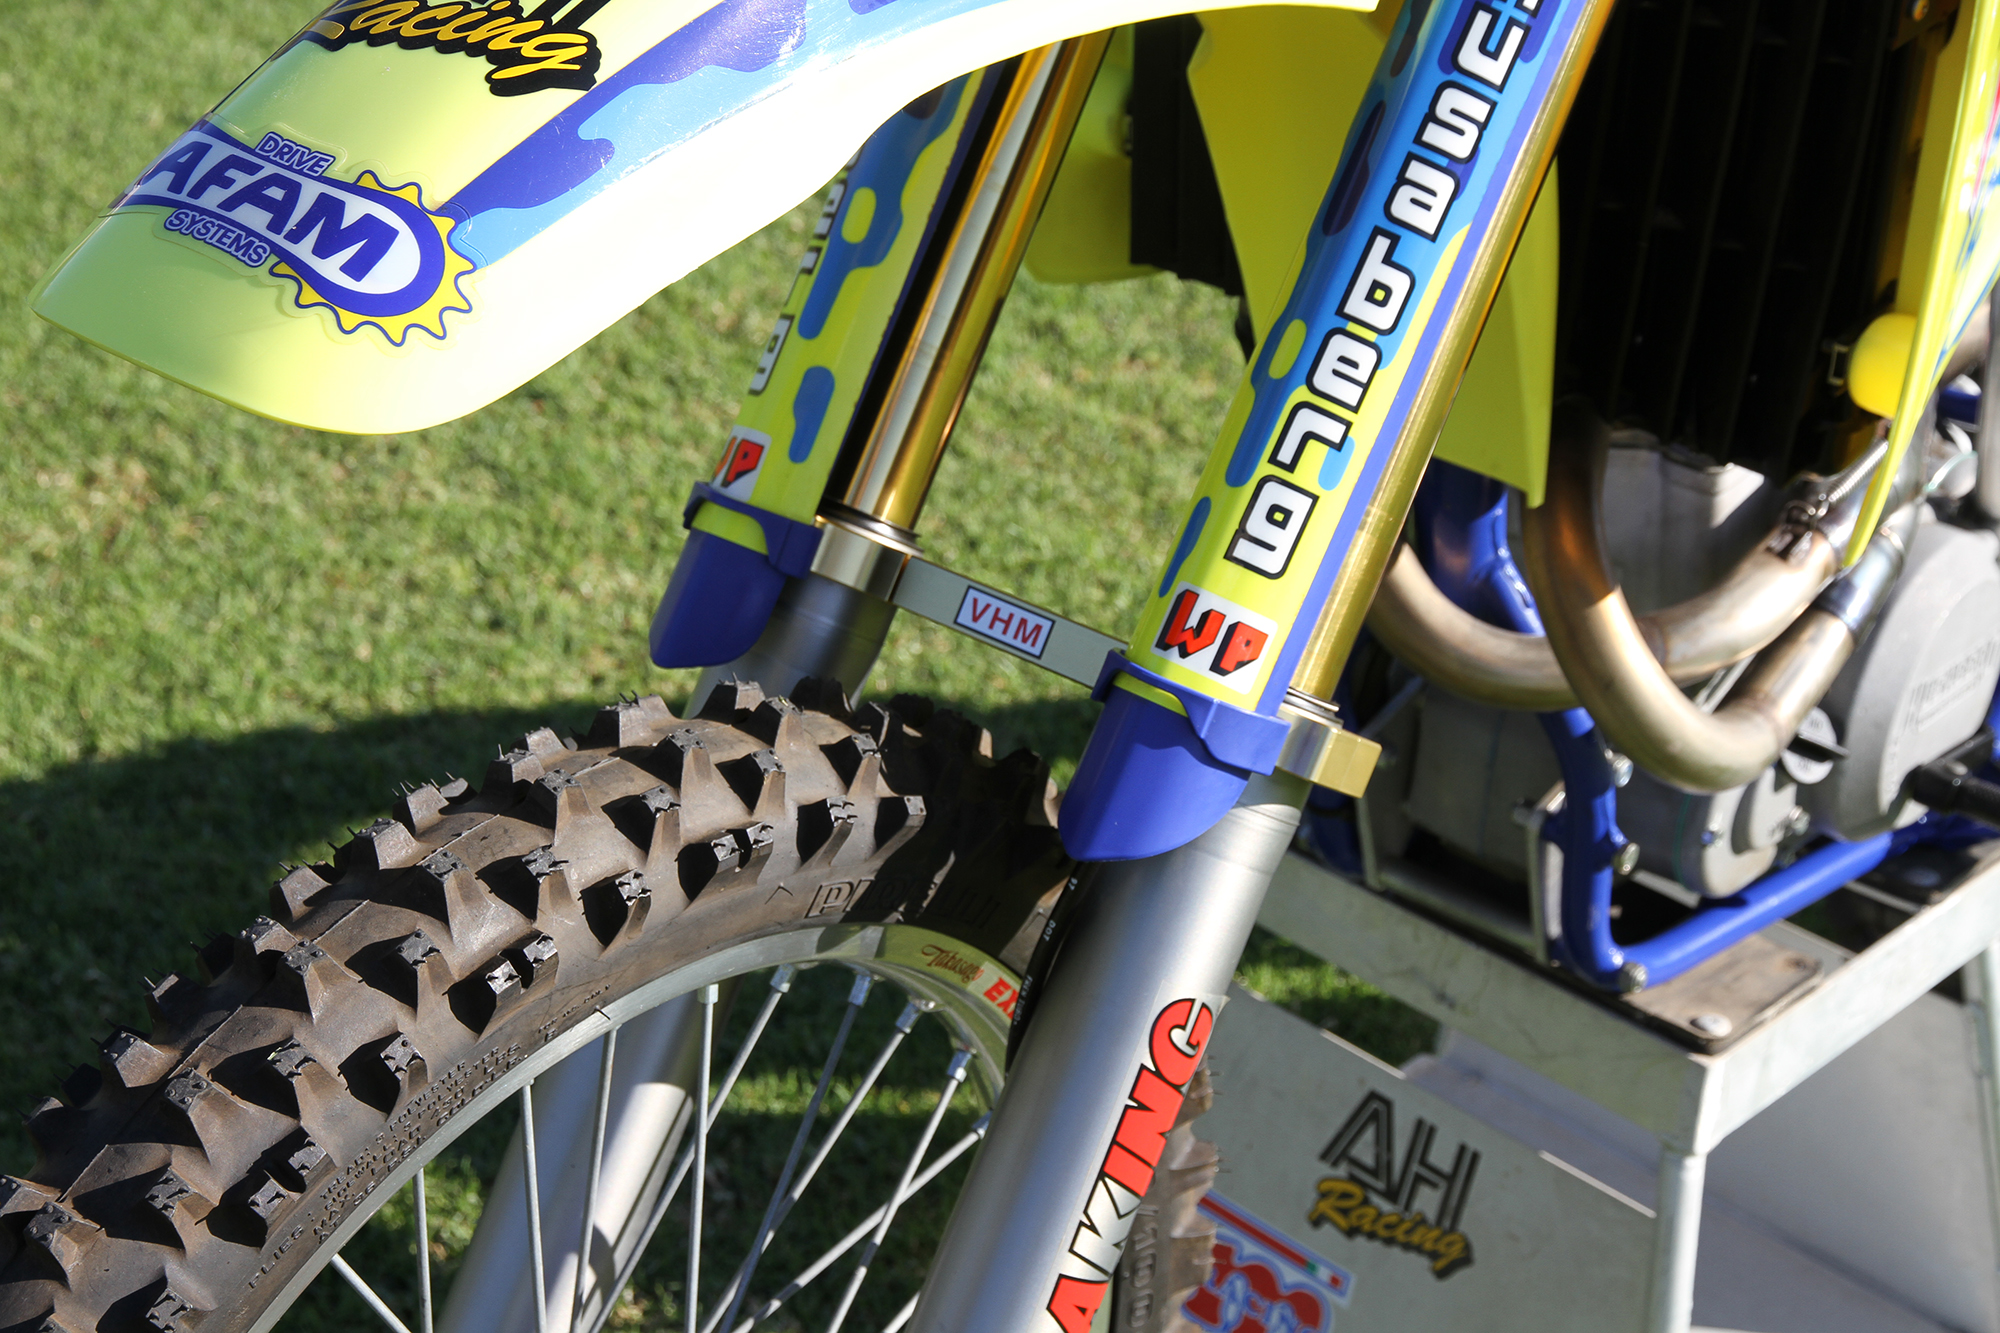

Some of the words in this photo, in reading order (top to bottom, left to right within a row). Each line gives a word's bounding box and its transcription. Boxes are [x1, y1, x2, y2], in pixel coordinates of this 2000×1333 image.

[257, 132, 335, 177] DRIVE
[146, 140, 399, 283] AFAM
[165, 209, 270, 268] SYSTEMS
[968, 600, 1043, 648] VHM
[1155, 588, 1269, 676] WP
[921, 944, 984, 982] Takasago
[1043, 920, 1056, 941] DOT
[387, 1059, 468, 1132] POLYESTER
[415, 1044, 501, 1120] POLYESTER
[367, 1122, 424, 1177] LOAD
[1319, 1090, 1480, 1233] AH
[1308, 1178, 1474, 1280] Racing
